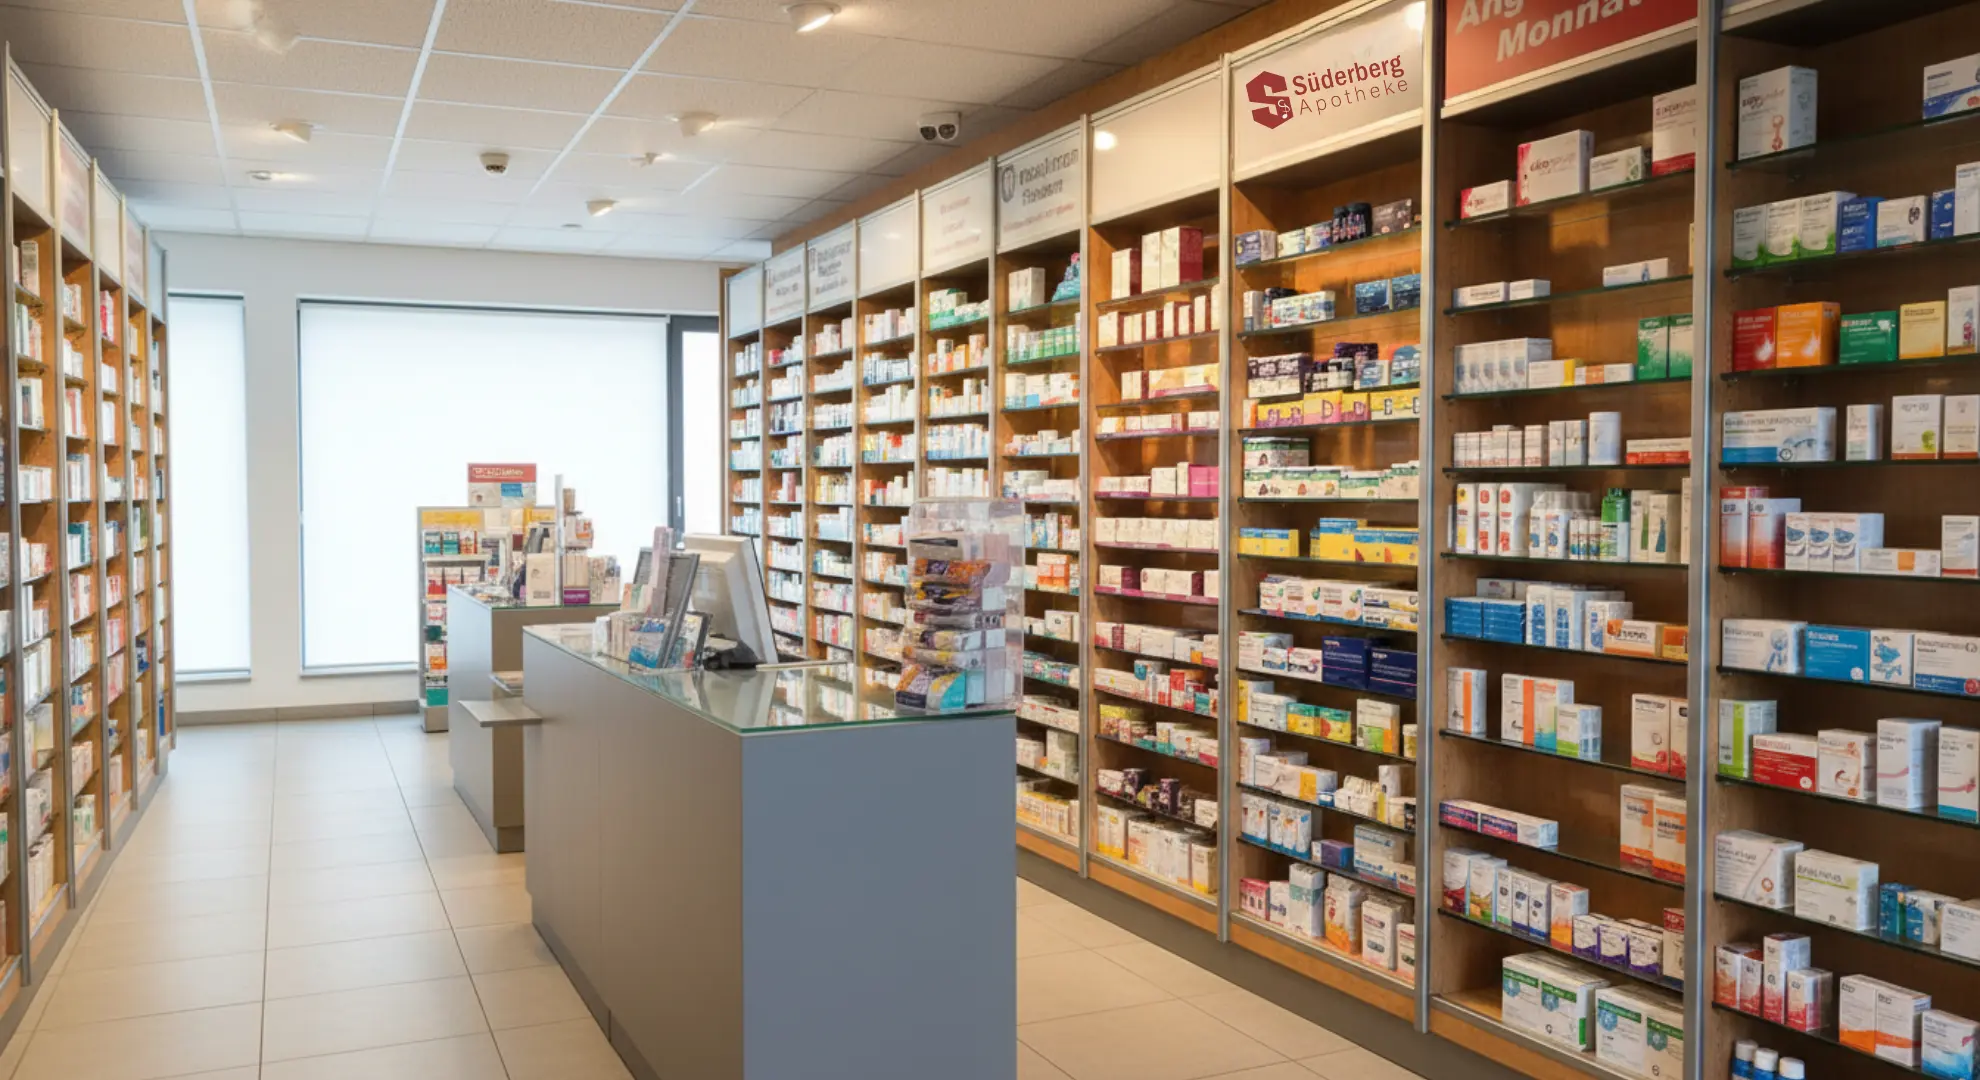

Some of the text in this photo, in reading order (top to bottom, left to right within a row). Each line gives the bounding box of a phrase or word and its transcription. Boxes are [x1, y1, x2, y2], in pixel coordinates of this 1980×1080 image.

[1496, 0, 1643, 63] Monna
[1292, 54, 1405, 96] Süderberg
[1299, 79, 1408, 116] Apotheke
